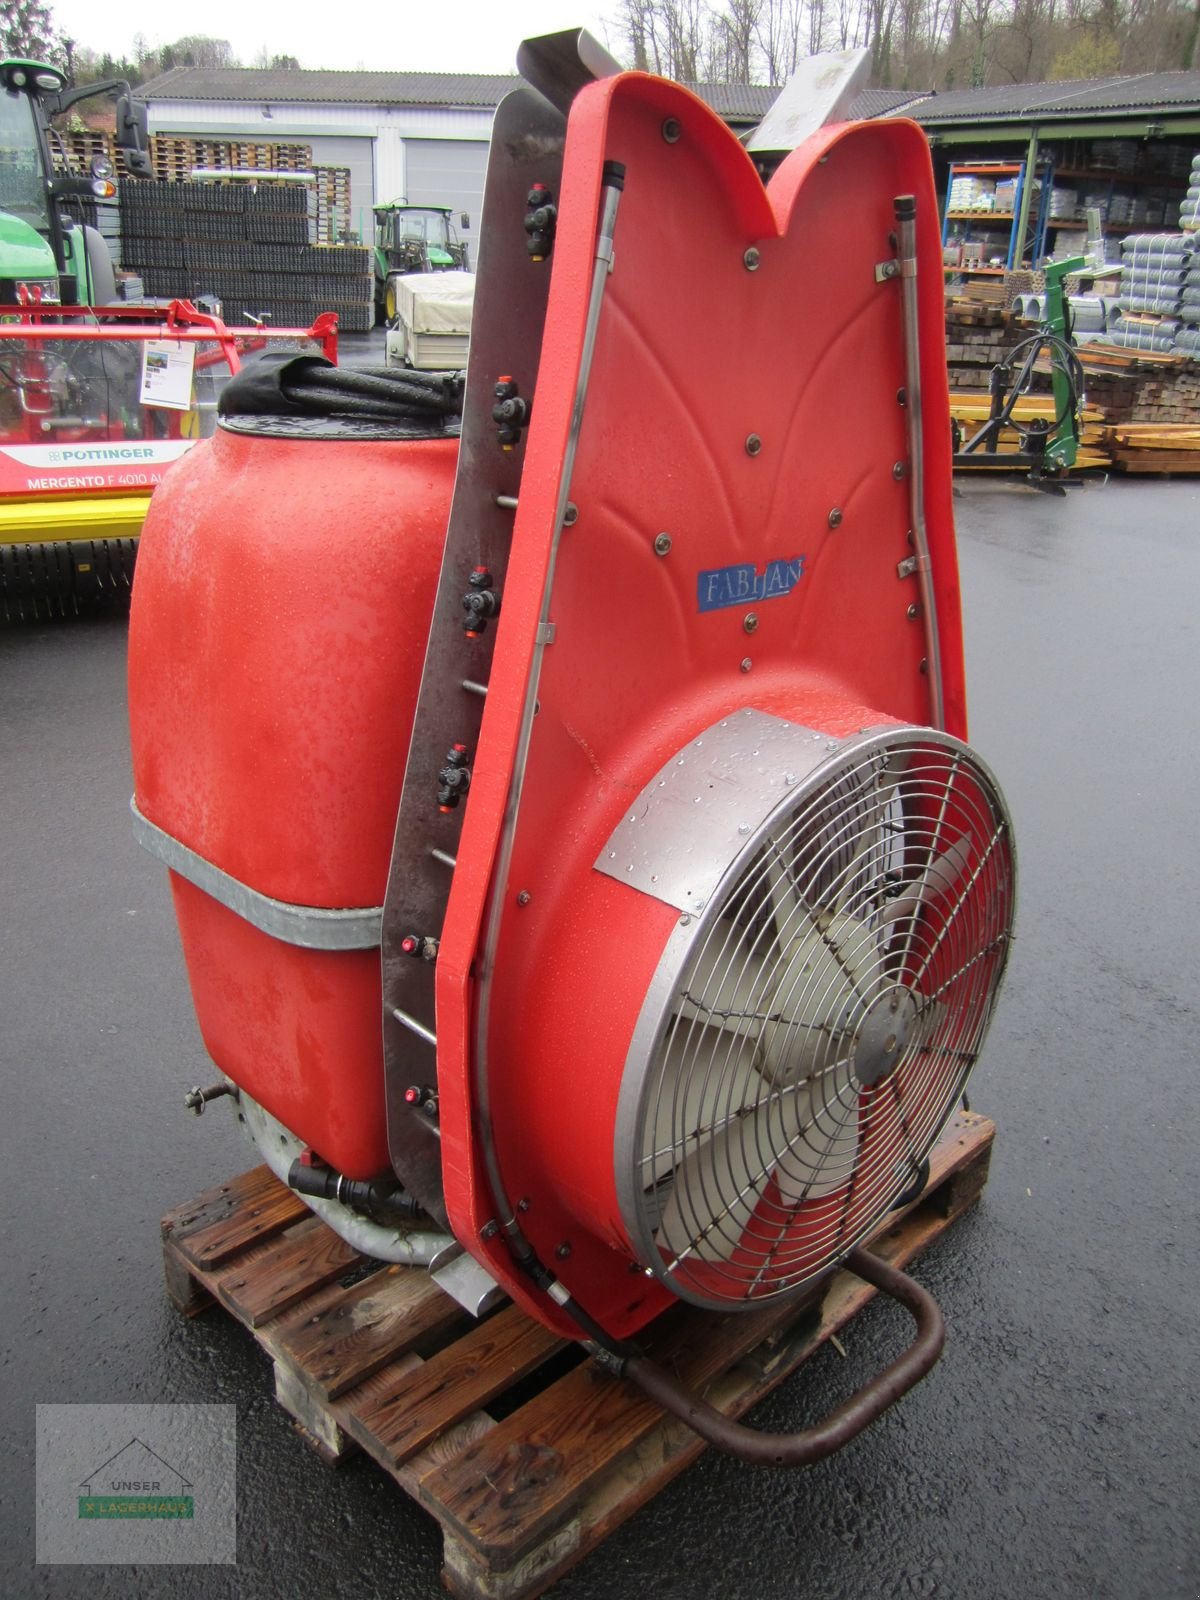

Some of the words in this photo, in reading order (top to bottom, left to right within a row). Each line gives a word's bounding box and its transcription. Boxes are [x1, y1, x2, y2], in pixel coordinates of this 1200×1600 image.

[27, 475, 105, 489] MERGENTO
[108, 475, 115, 485] F
[118, 473, 147, 485] 4010
